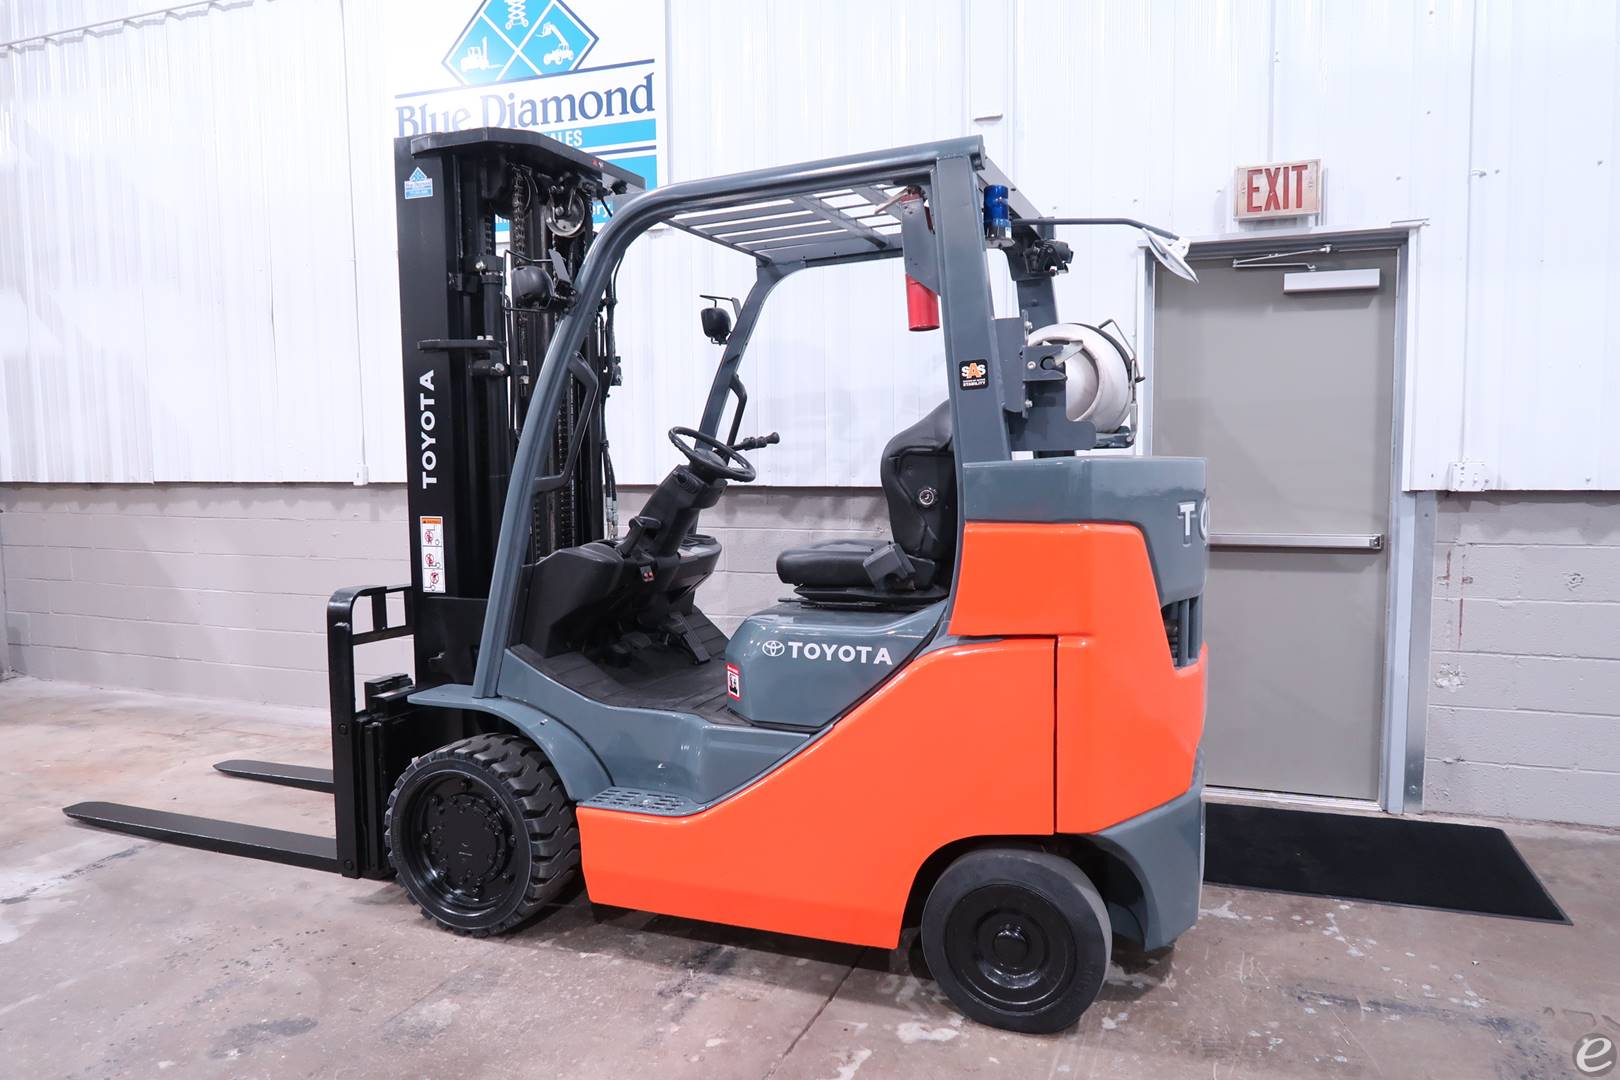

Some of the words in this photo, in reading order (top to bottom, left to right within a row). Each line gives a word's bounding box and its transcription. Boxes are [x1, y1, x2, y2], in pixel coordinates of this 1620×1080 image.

[396, 103, 471, 138] Blue
[480, 72, 655, 128] Diamond
[1247, 164, 1308, 213] EXIT
[419, 369, 437, 490] TOYOTA
[788, 641, 893, 666] TOYOTA
